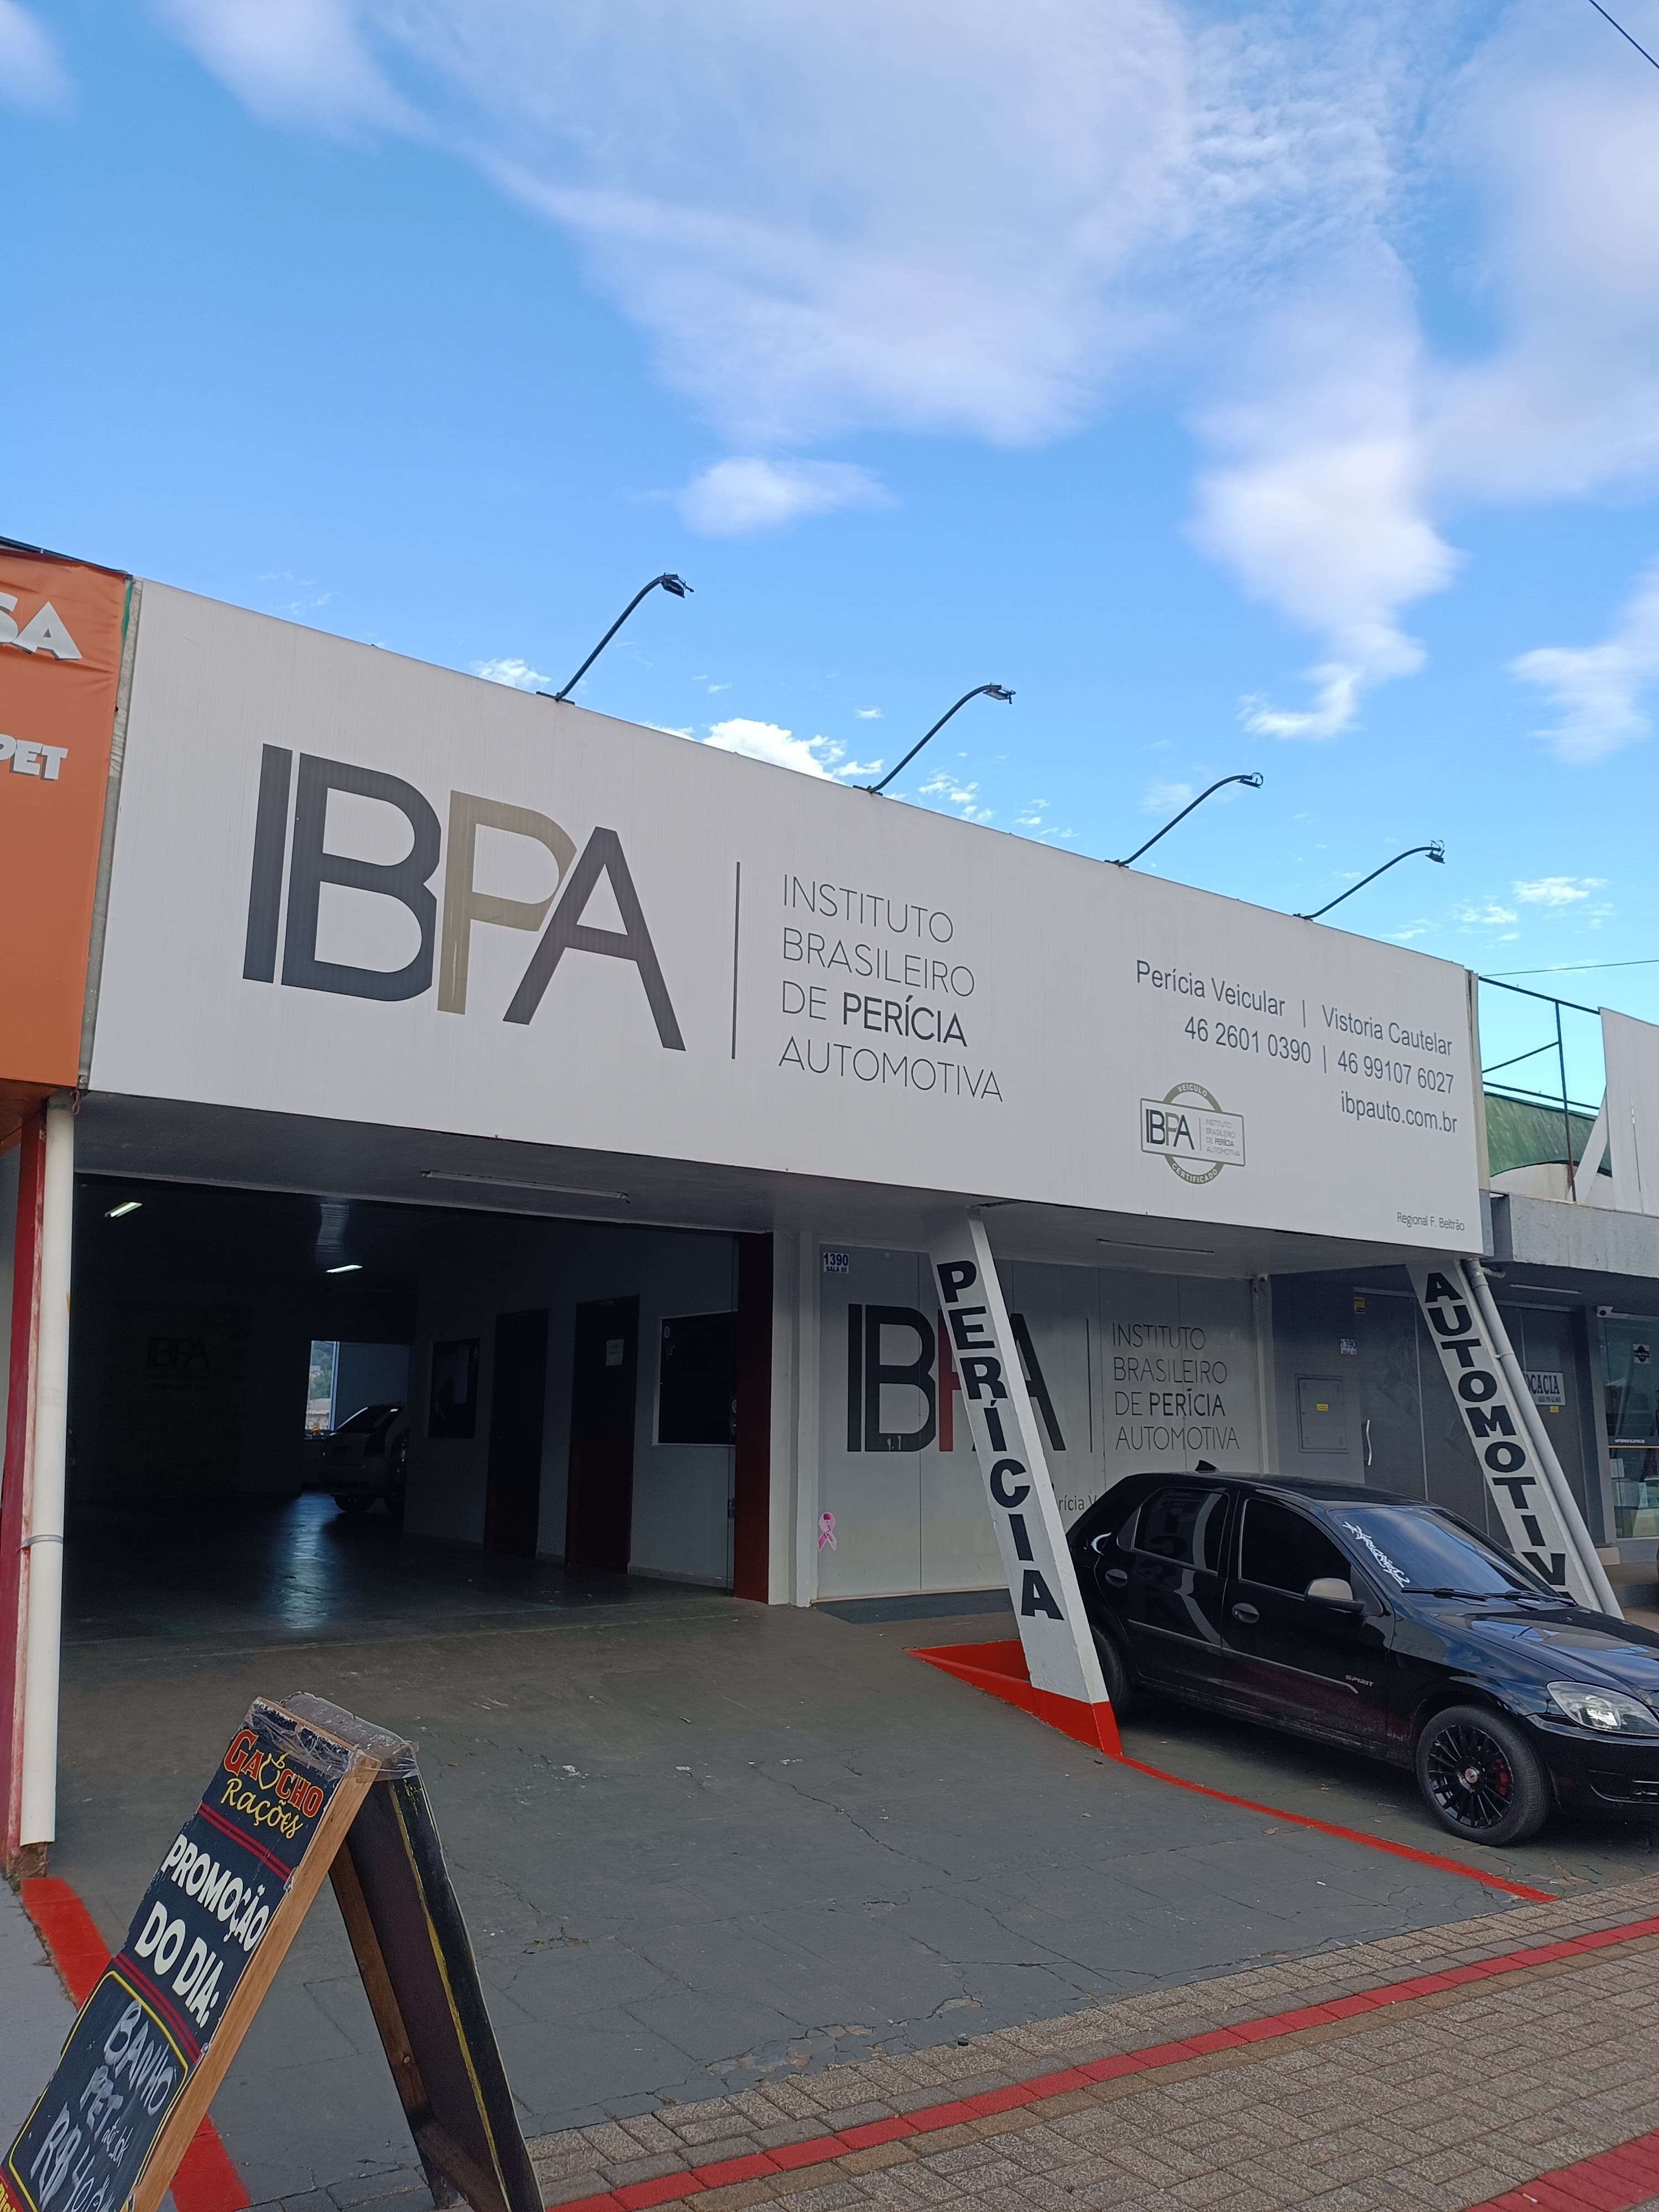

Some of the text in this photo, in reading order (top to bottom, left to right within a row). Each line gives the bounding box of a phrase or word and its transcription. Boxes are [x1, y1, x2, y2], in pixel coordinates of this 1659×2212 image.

[242, 743, 686, 1051] IBPA
[784, 874, 953, 943] INSTITUTO
[783, 927, 974, 997] BRASILEIRO
[782, 980, 968, 1047] DE PERÍCIA
[1136, 959, 1206, 998] Perícia
[1211, 977, 1286, 1016] Veicular
[1322, 1004, 1383, 1040] Vistoria
[1388, 1022, 1453, 1056] Cautelar
[778, 1036, 1003, 1102] AUTOMOTIVA
[1184, 1016, 1208, 1042] 46
[1215, 1022, 1259, 1053] 2601
[1267, 1034, 1311, 1064] 0390
[1337, 1050, 1358, 1074] 46
[1363, 1055, 1412, 1085] 99107
[1417, 1067, 1454, 1094] 6027
[1177, 1083, 1208, 1097] VEICULO
[1145, 1108, 1195, 1150] IBPA
[1205, 1119, 1232, 1129] INSTITUTO
[1206, 1128, 1235, 1138] BRASILEIRO
[1340, 1090, 1458, 1134] ibpauto.com.br
[1206, 1146, 1240, 1157] AUTOMOTIVA
[1214, 1138, 1235, 1147] PERÍCIA
[1172, 1162, 1218, 1183] CERTIFICADO
[1396, 1212, 1465, 1231] Regional F. Beltrão
[824, 1253, 848, 1266] 1390
[1113, 1322, 1206, 1350] INSTITUTO
[1114, 1357, 1227, 1384] BRASILEIRO
[1115, 1388, 1225, 1417] DE PERÍCIA
[936, 1260, 1065, 1620] PERÍCIA
[1115, 1426, 1240, 1450] AUTOMOTIVA
[1424, 1272, 1577, 1605] AUTOMOTIV
[1058, 1495, 1084, 1511] rícia
[1345, 1674, 1374, 1687] SPIRIT
[220, 1777, 304, 1840] Rações
[161, 1834, 270, 1953] PROMOÇÃO
[134, 1900, 224, 2029] DO DIA:
[103, 1999, 174, 2116] BANHO
[80, 2065, 124, 2142] PET
